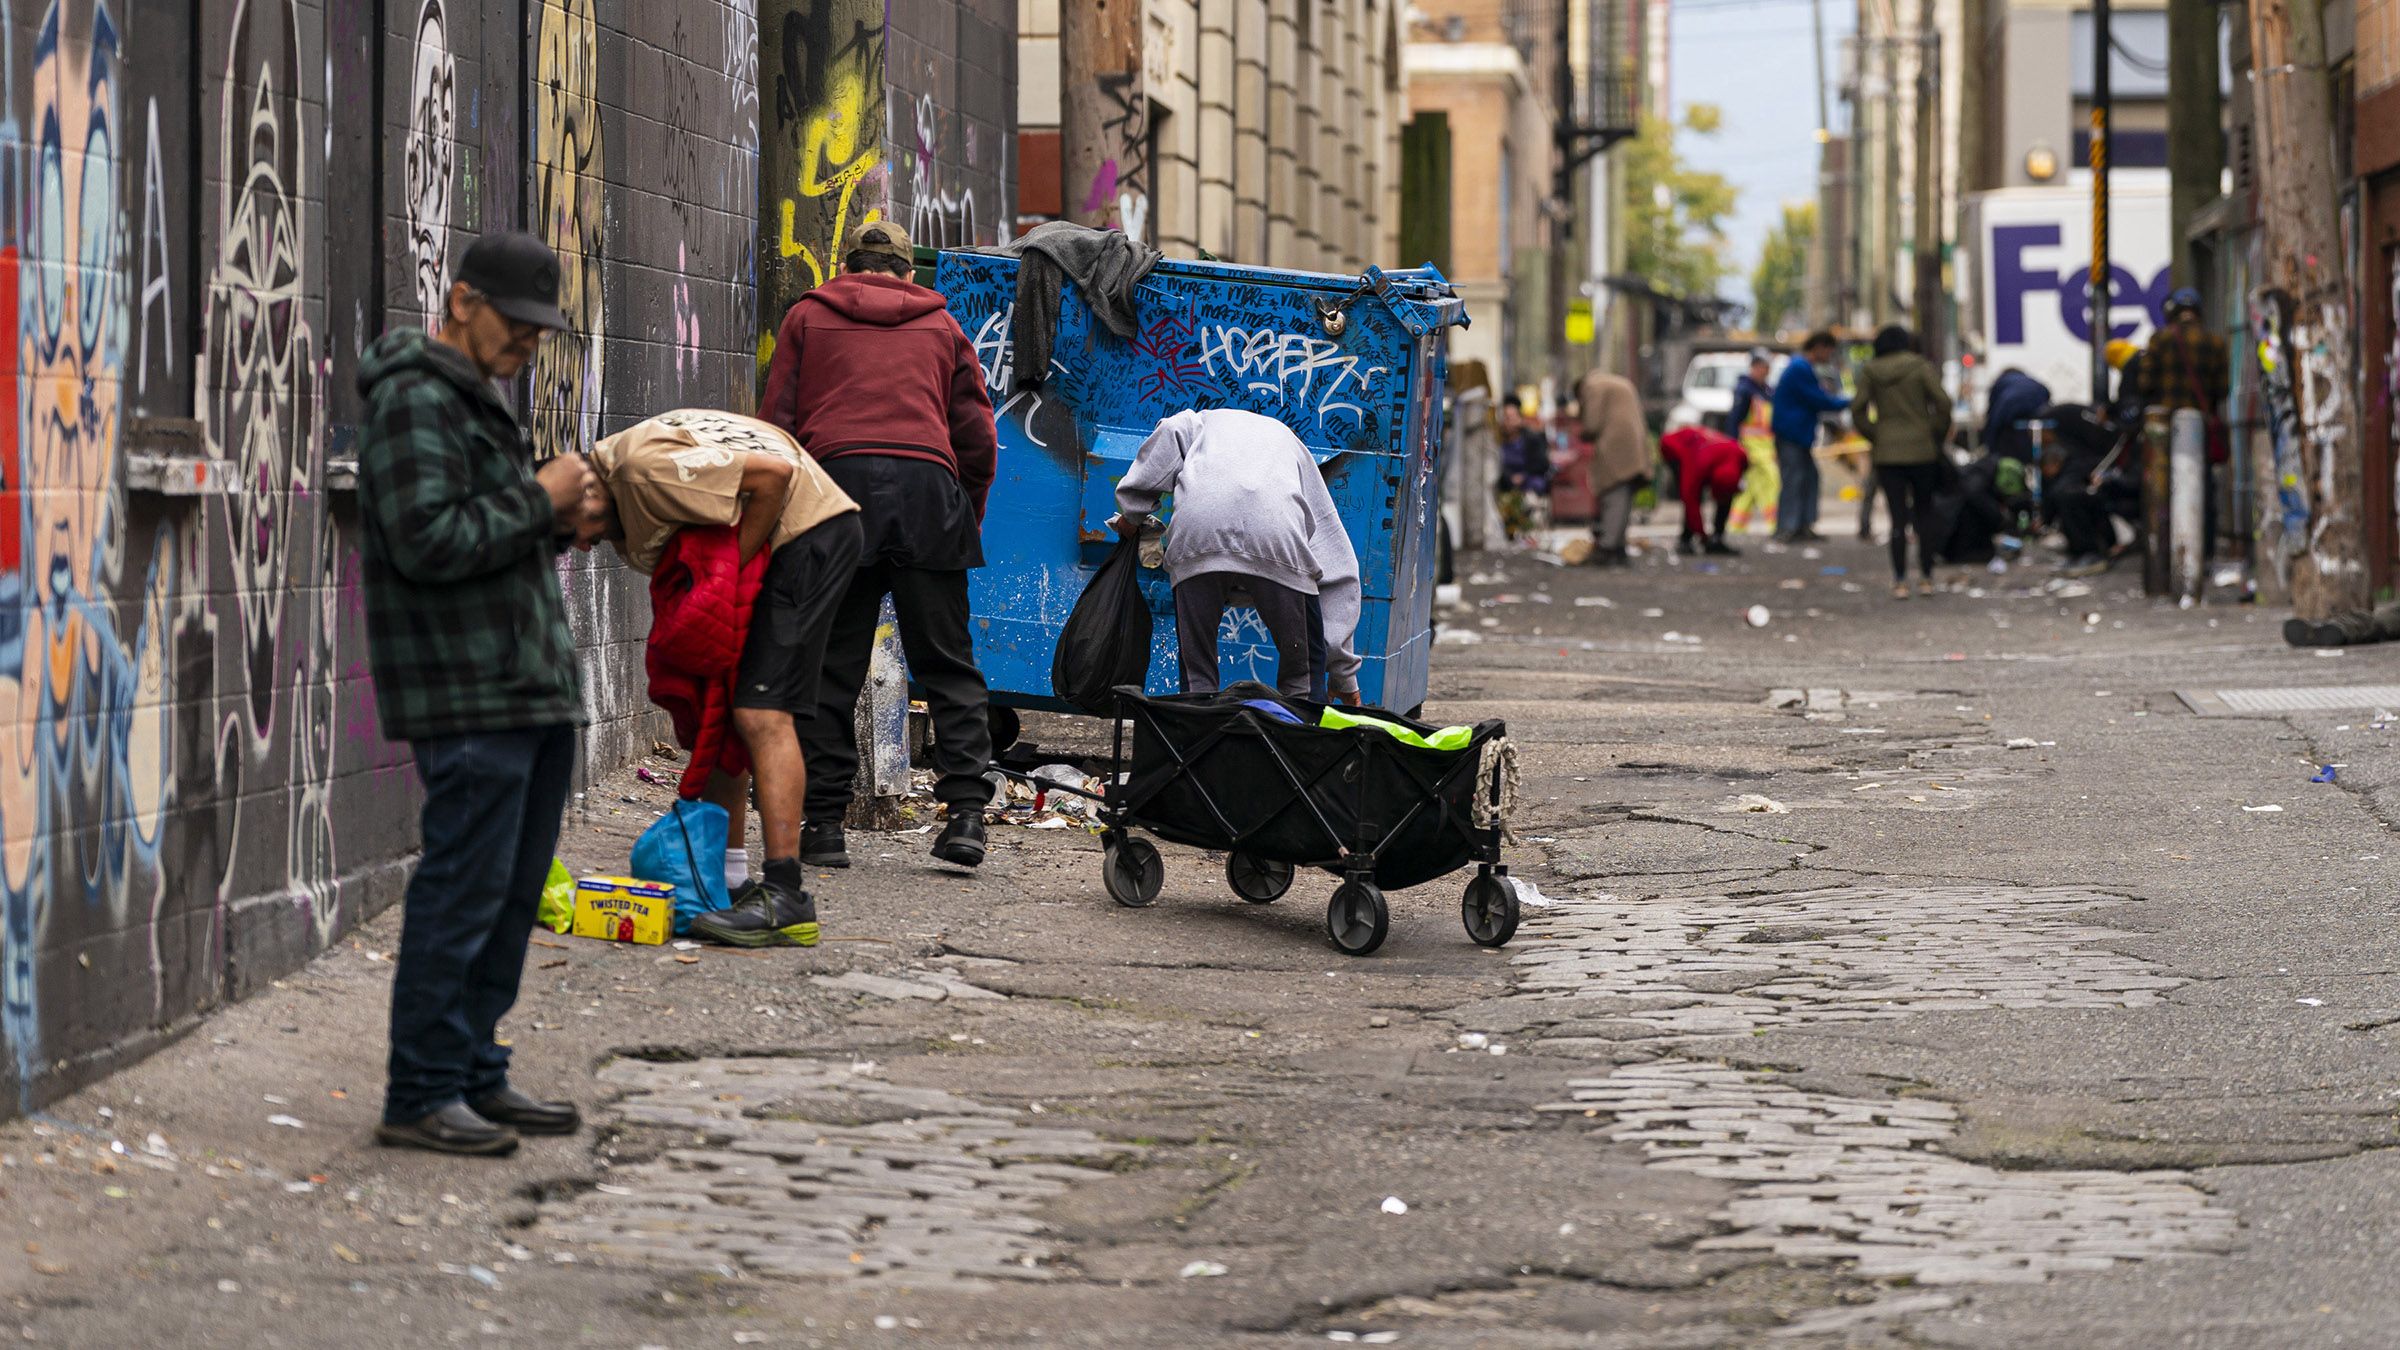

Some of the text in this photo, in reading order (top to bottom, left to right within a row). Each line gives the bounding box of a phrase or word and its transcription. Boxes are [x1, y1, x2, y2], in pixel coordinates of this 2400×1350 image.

[1167, 277, 1210, 296] MORE
[1993, 225, 2172, 345] Fe
[590, 899, 649, 916] TWISTED TEA
